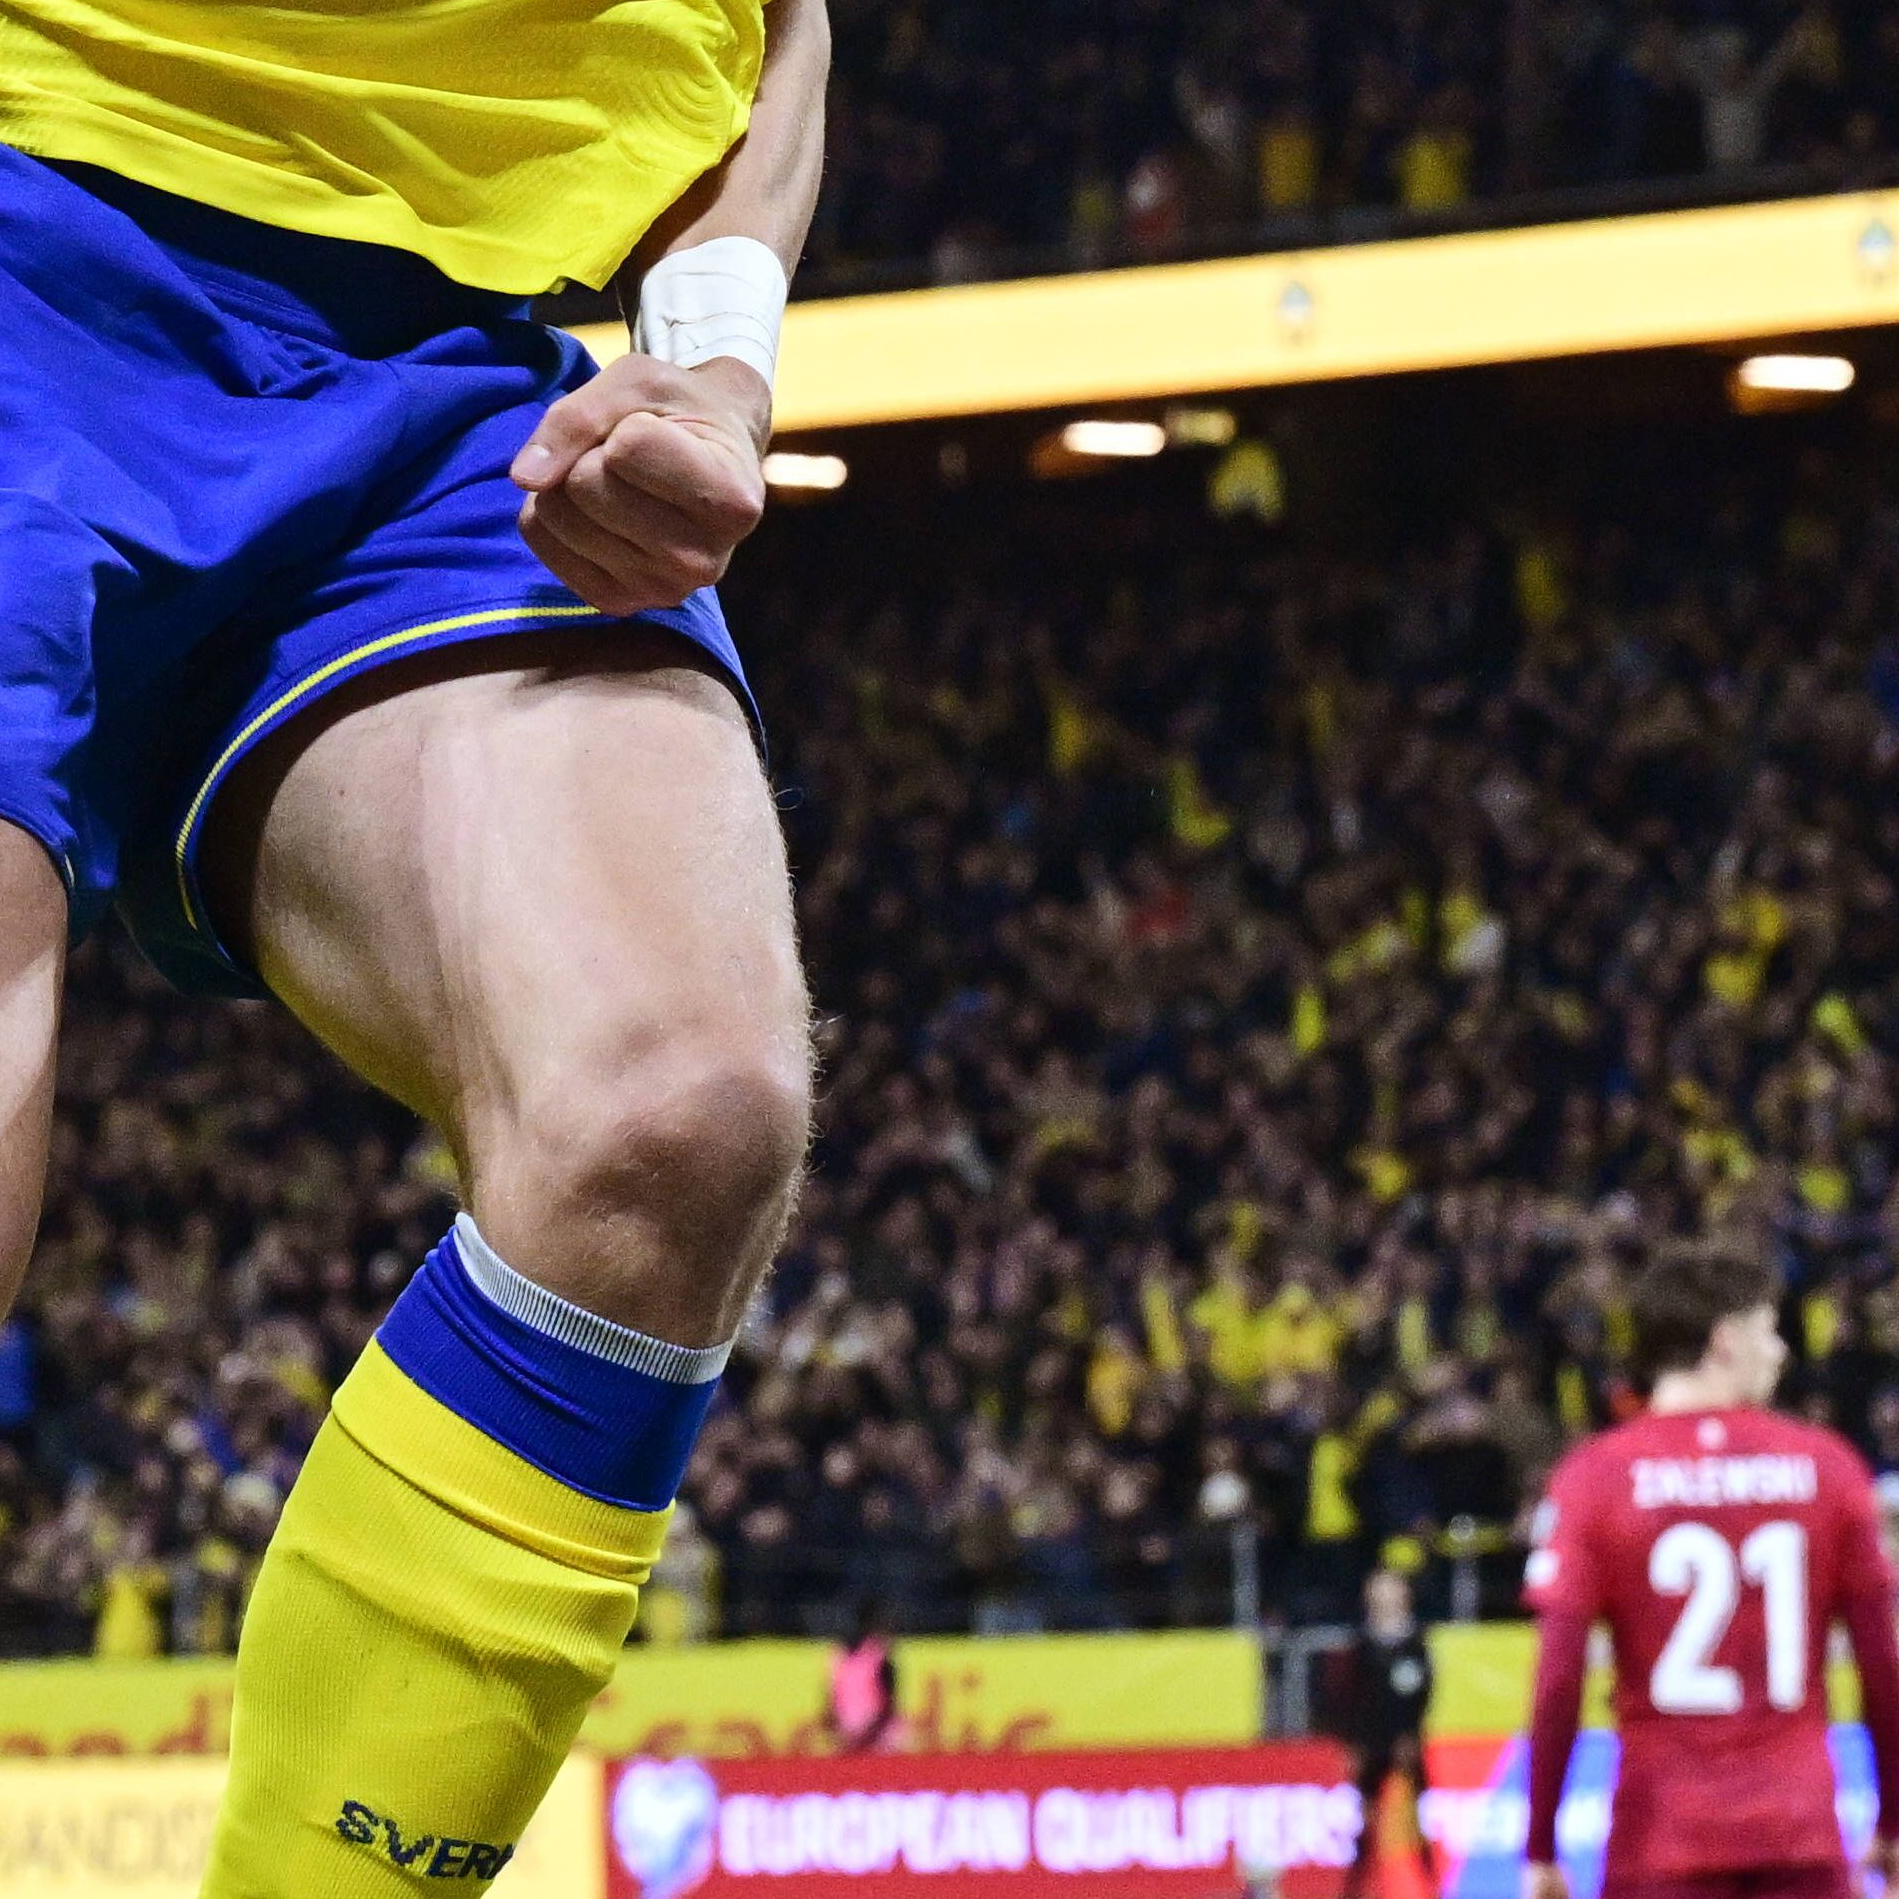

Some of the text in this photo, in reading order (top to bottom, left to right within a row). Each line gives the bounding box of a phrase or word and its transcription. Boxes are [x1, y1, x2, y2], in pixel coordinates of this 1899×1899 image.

[1630, 1454, 1818, 1508] ZALEWSKI
[1648, 1520, 1810, 1715] 21
[719, 1790, 1030, 1876] EUROPEAN
[1034, 1784, 1364, 1873] QUALIFIERS
